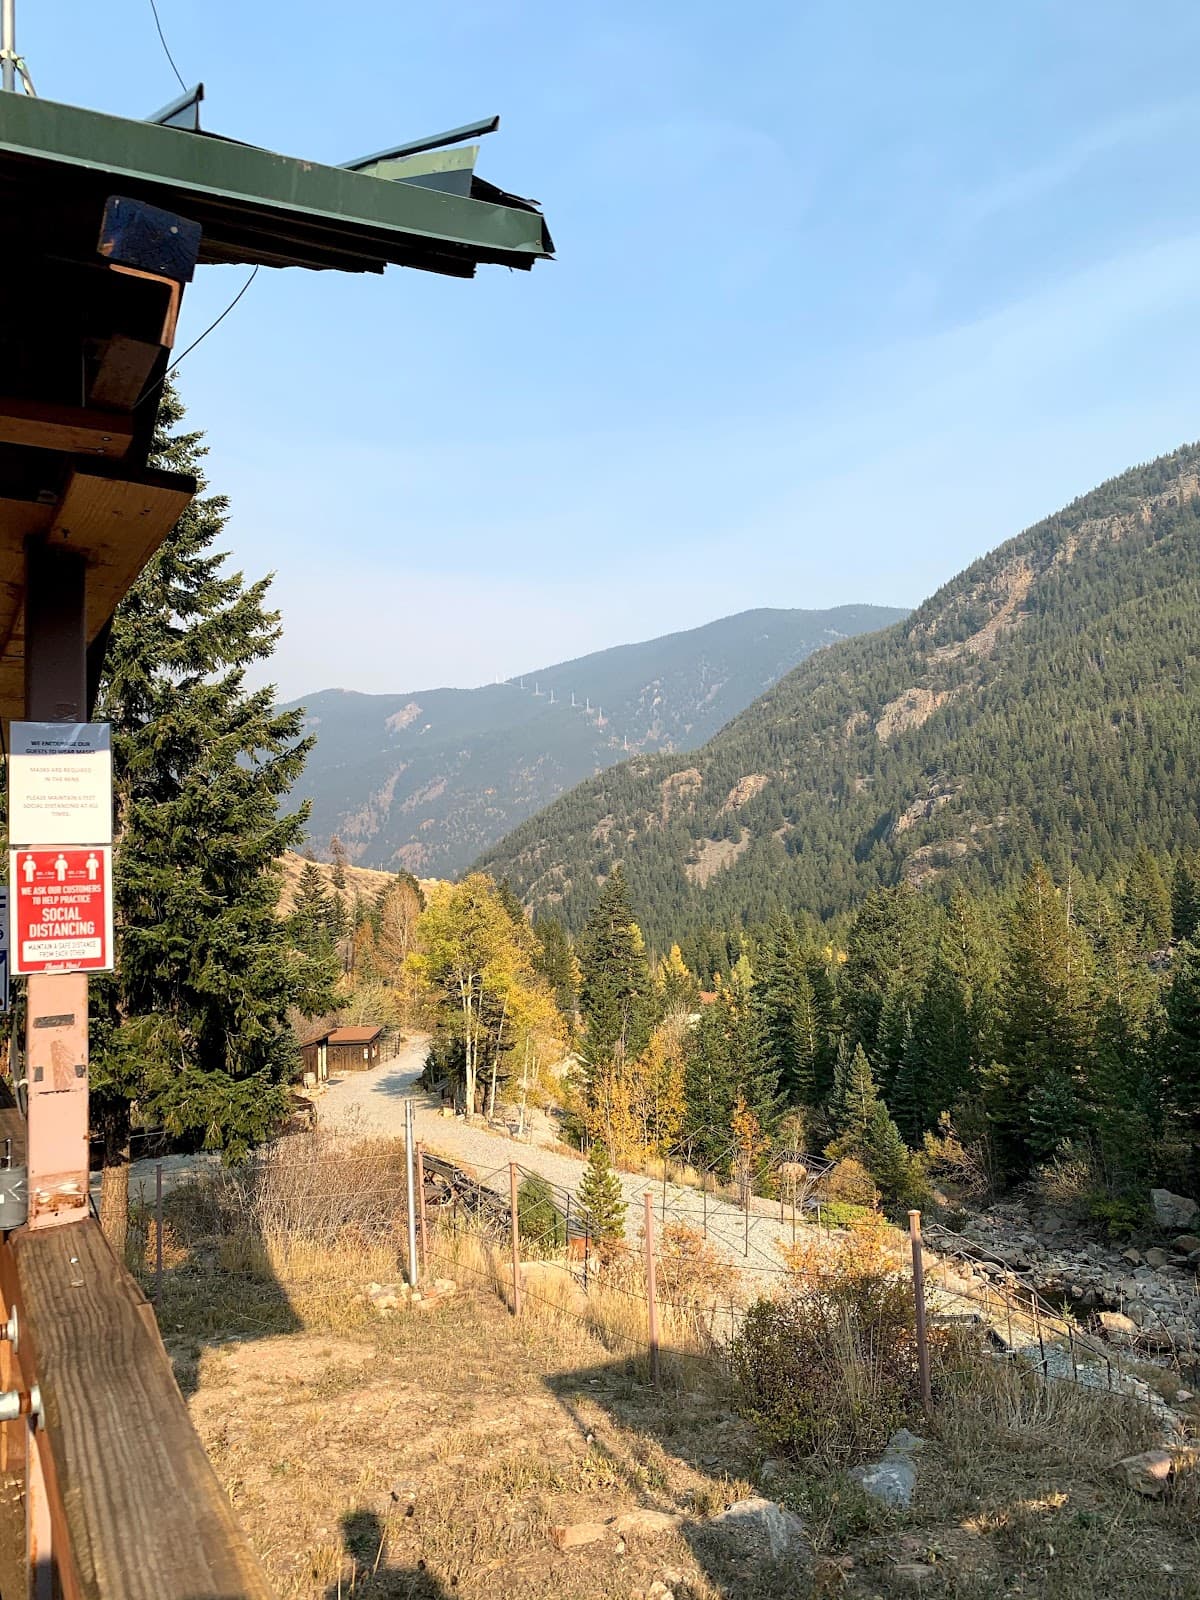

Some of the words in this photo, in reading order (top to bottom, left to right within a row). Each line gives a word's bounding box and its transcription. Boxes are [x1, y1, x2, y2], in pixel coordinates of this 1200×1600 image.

[21, 887, 32, 895] WE
[33, 886, 46, 895] ASK
[48, 886, 62, 894] OUR
[62, 884, 101, 894] CUSTOMERS
[32, 897, 40, 905] TO
[42, 896, 59, 904] HELP
[60, 895, 90, 904] PRACTICE
[42, 907, 82, 922] SOCIAL
[29, 921, 95, 938] DISTANCING
